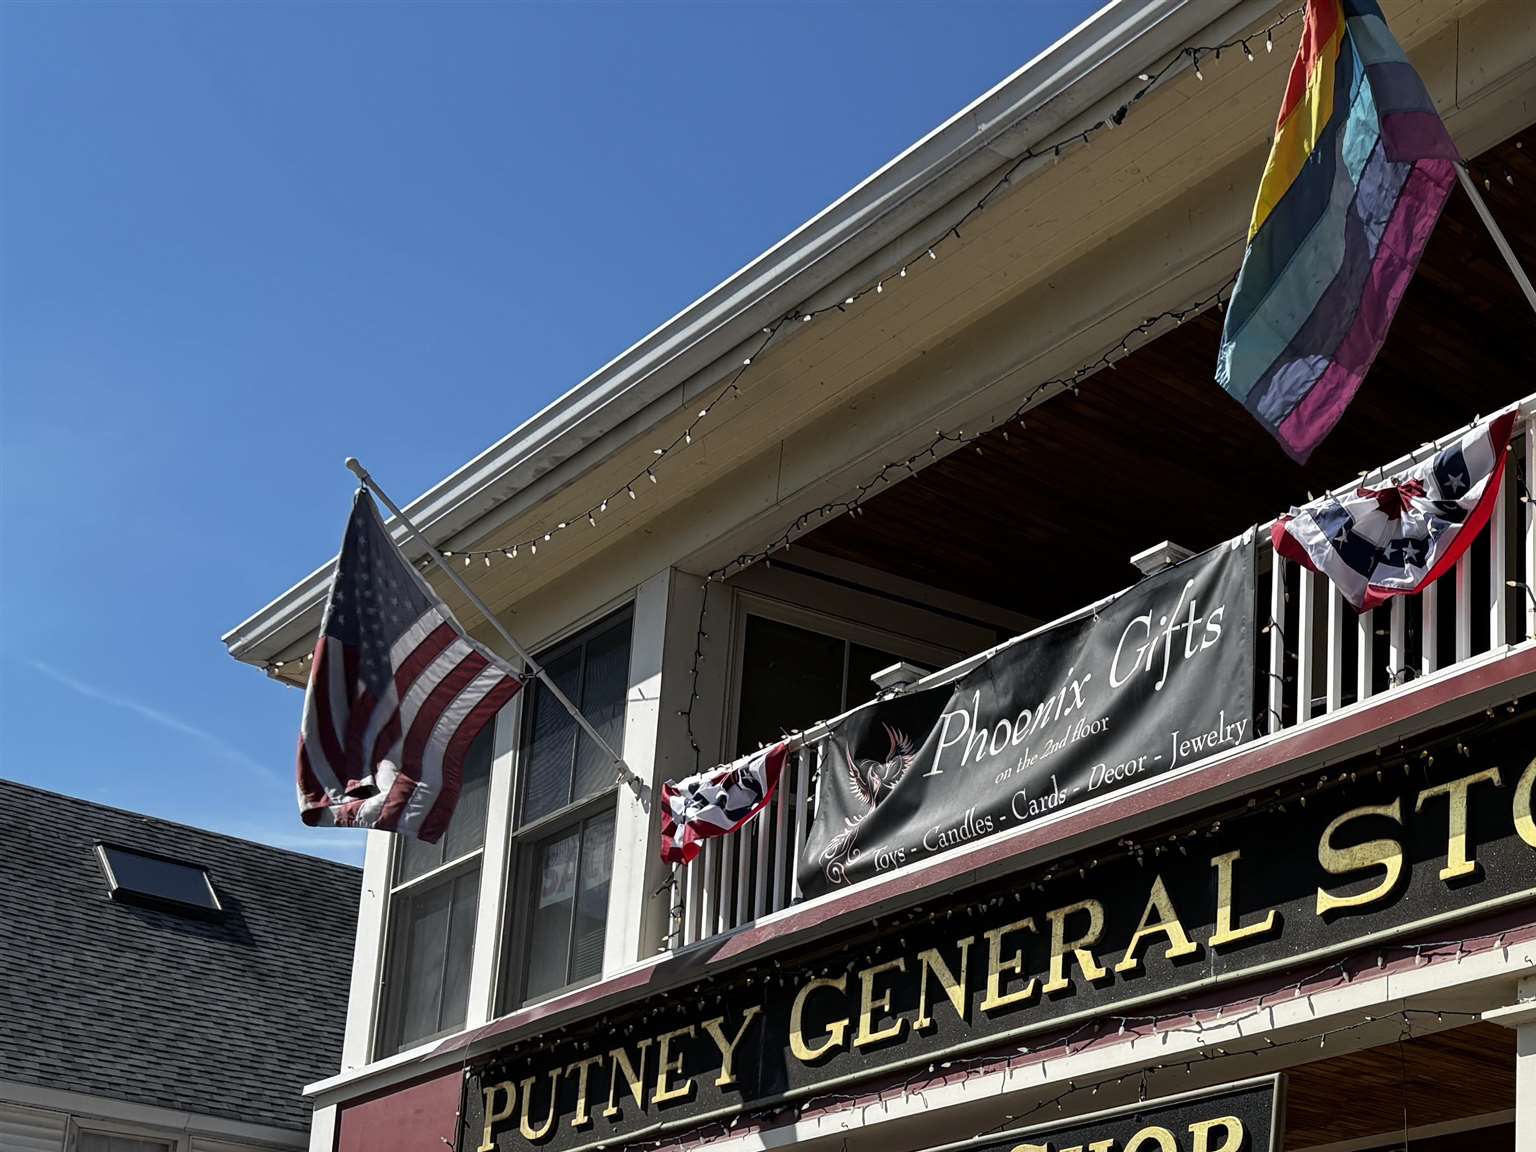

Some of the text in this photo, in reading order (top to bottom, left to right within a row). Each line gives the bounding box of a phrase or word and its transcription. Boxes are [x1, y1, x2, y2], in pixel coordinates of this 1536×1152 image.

[922, 579, 1226, 778] Phoenix Gifts
[995, 716, 1110, 784] on the 2nd floor
[873, 844, 906, 873] Toys
[923, 807, 994, 852] Candles
[1011, 774, 1067, 820] Cards
[1086, 755, 1147, 792] Decor
[1169, 710, 1248, 769] Jewelry
[790, 849, 1280, 1061] GENERAL
